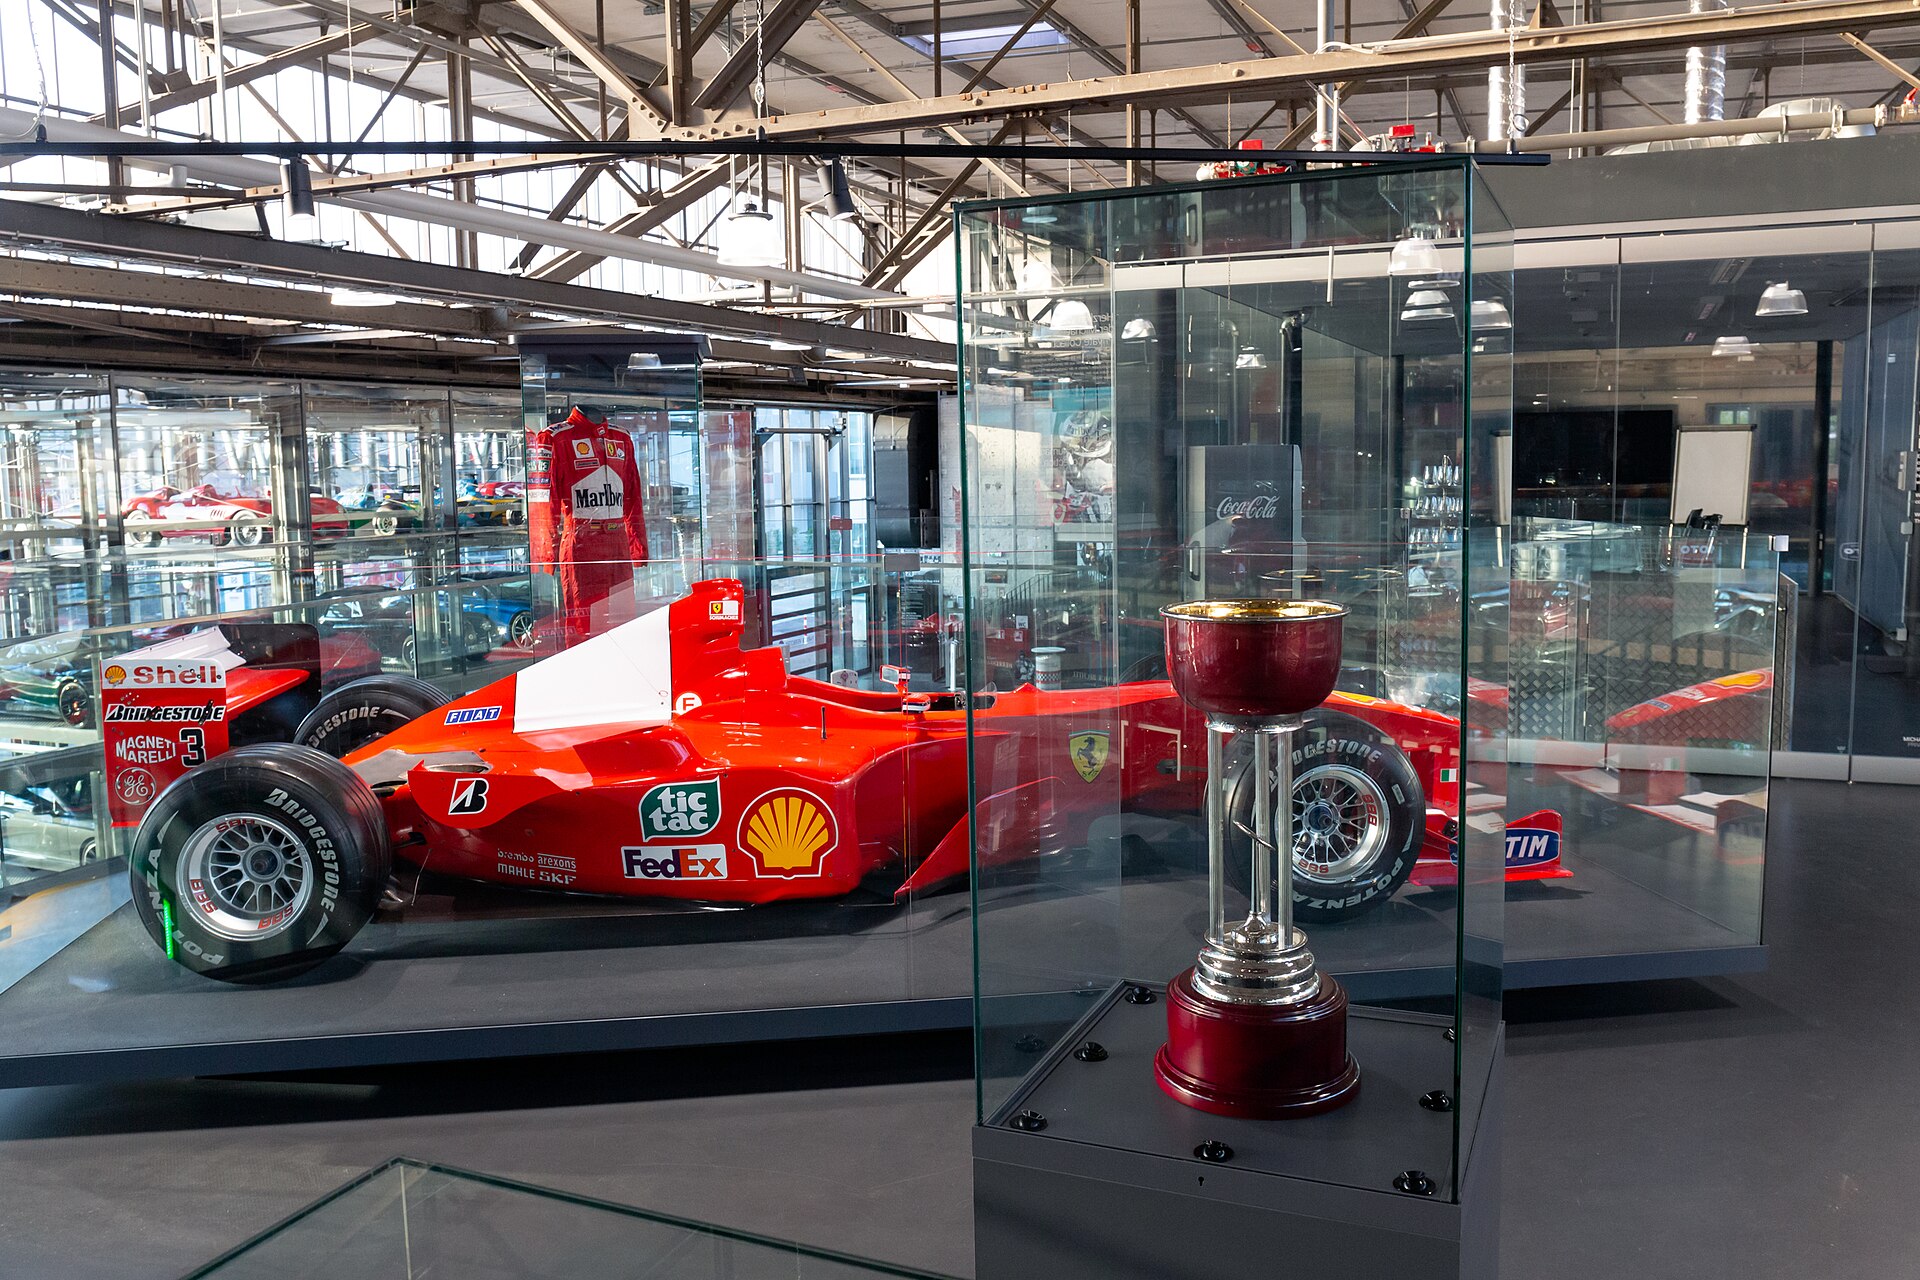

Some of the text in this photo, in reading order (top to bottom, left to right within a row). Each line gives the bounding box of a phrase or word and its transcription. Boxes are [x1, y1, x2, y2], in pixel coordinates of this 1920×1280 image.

[1217, 496, 1280, 520] Coca-Cola
[133, 665, 217, 684] Shell
[105, 704, 226, 722] BRIDGESTONE
[450, 708, 498, 723] FIAT
[116, 735, 176, 759] MAGNETI
[116, 746, 176, 764] MARELLI
[179, 728, 206, 767] 3
[657, 787, 707, 813] tic
[649, 807, 709, 831] tac
[264, 788, 340, 912] BRIDGESTONE
[1505, 834, 1549, 859] TIM
[497, 848, 577, 870] brembo arexons
[623, 848, 724, 878] FedEx
[498, 863, 577, 885] MAHLE SKF
[190, 879, 218, 913] BBS
